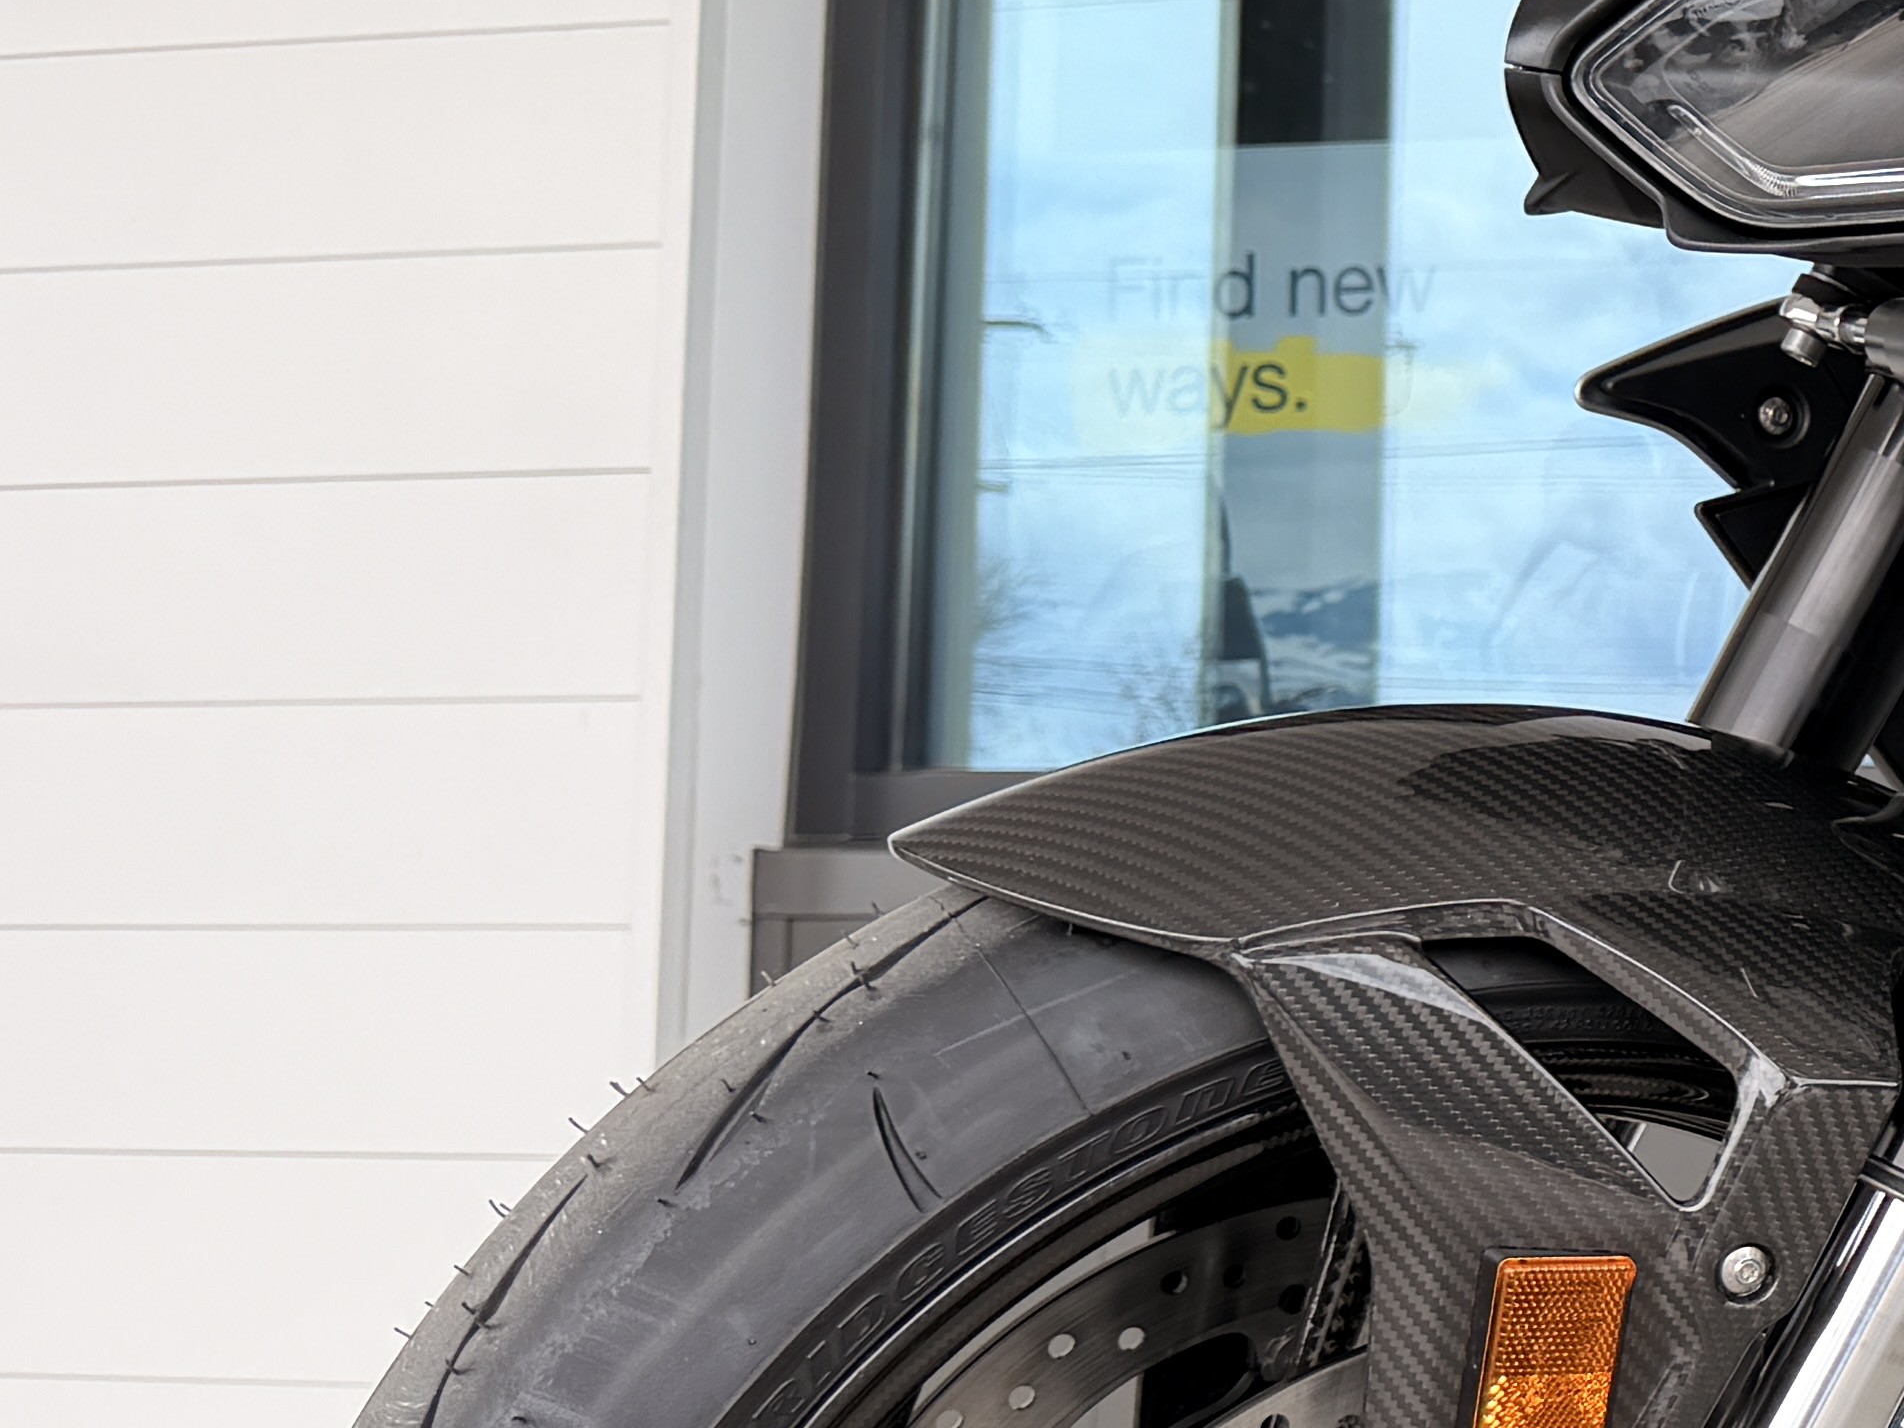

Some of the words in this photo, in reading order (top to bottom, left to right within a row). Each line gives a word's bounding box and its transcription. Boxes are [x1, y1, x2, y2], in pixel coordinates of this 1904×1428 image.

[1108, 251, 1256, 320] Find
[1287, 263, 1434, 318] new
[1108, 361, 1308, 428] ways.
